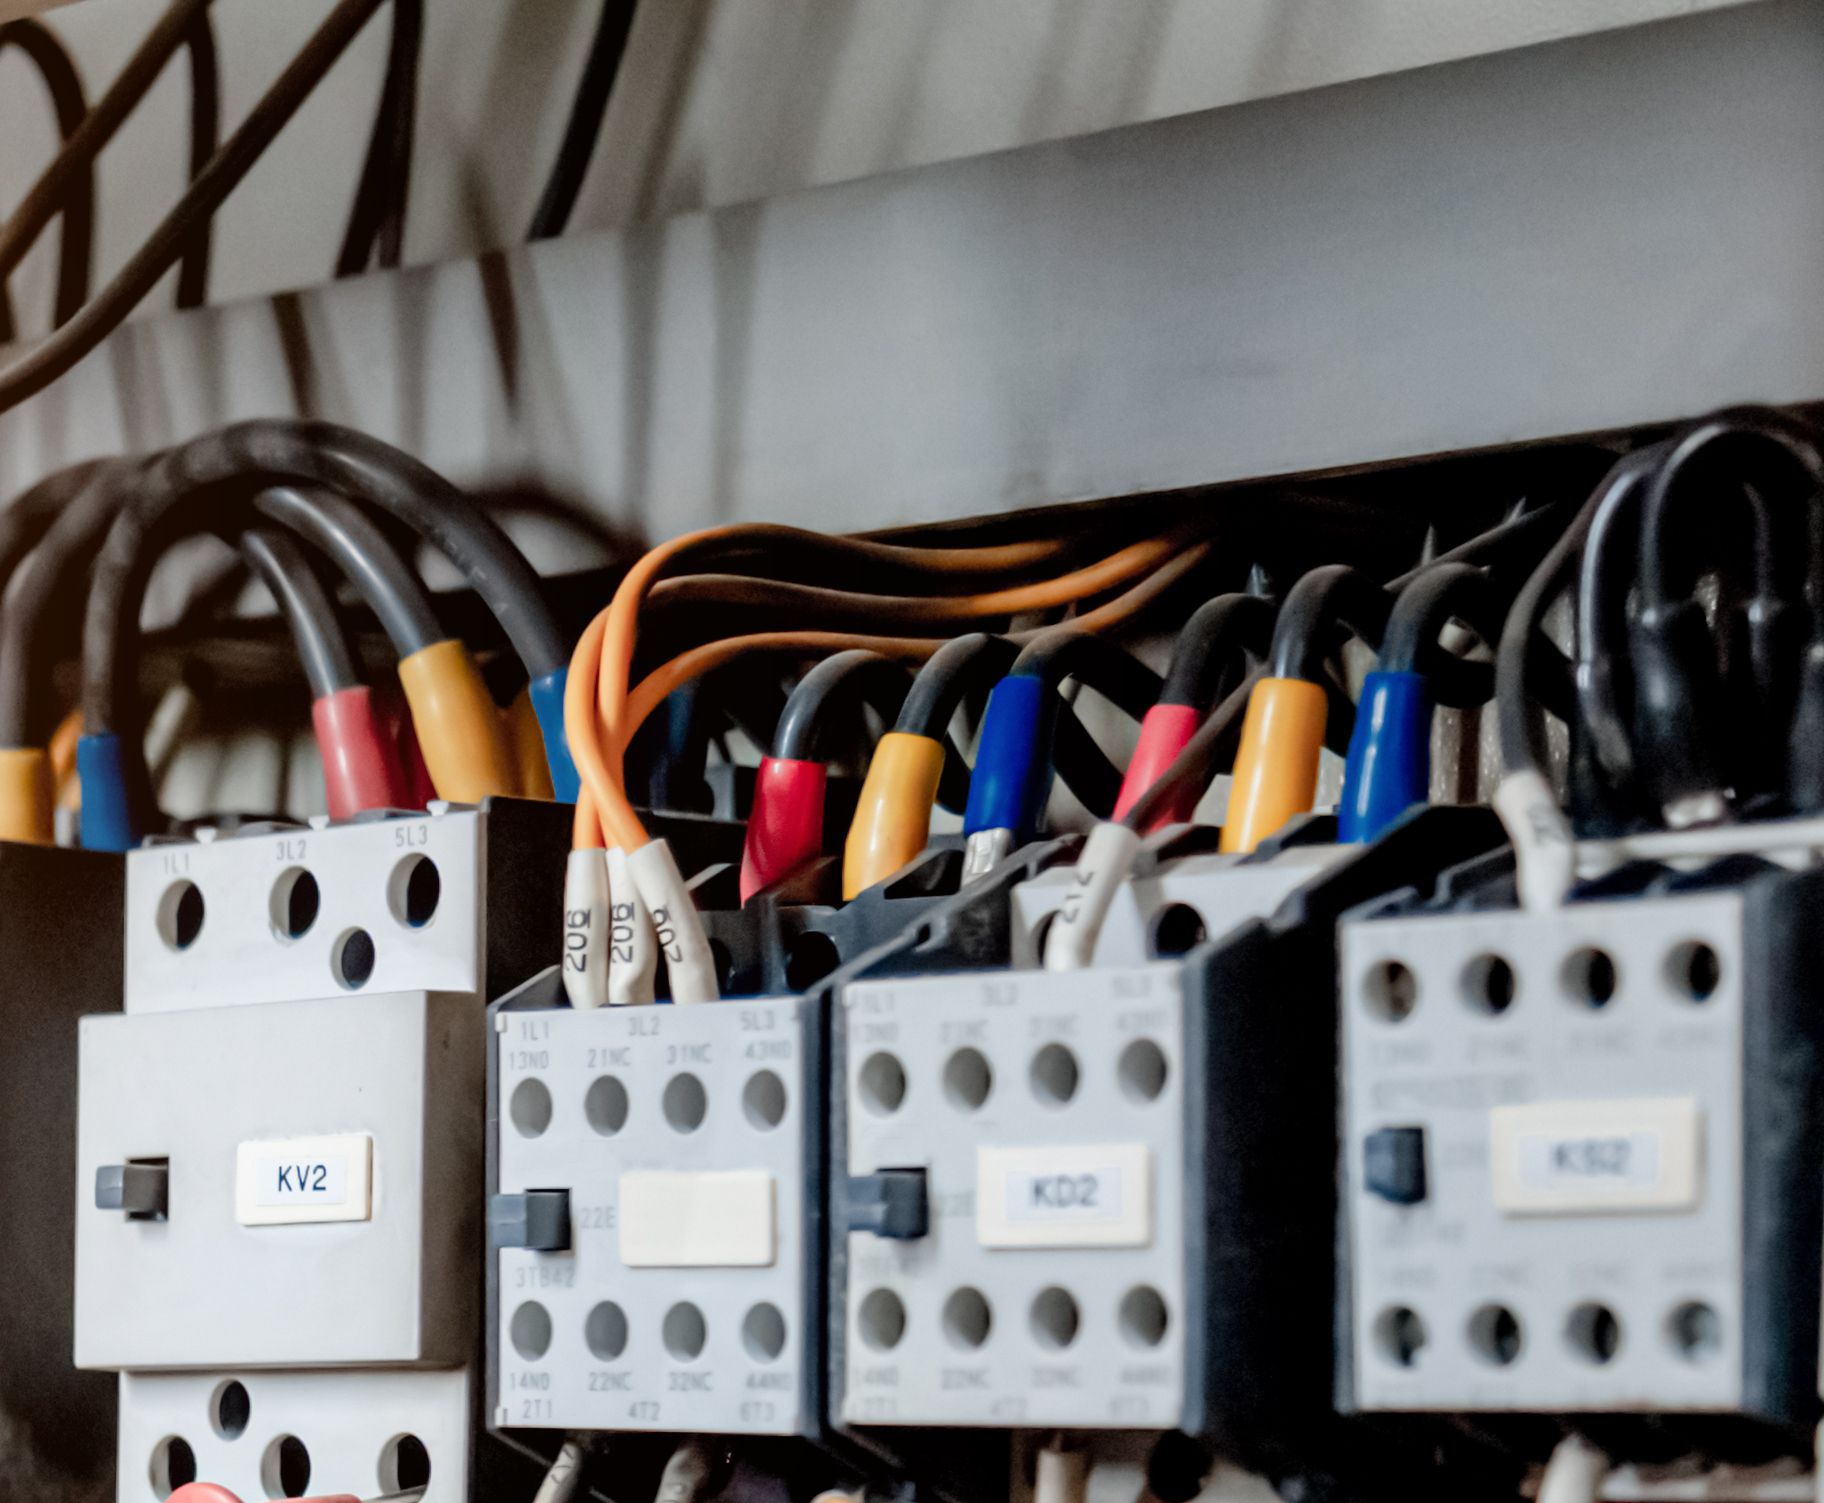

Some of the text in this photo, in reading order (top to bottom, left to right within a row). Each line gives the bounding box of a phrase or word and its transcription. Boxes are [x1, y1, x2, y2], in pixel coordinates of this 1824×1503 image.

[275, 839, 307, 862] 3L2
[394, 824, 429, 848] 5L3
[627, 1015, 661, 1037] 3L2
[738, 1010, 776, 1032] 5L3
[586, 1046, 632, 1069] 21NC
[665, 1043, 712, 1066] 31NC
[276, 1164, 328, 1193] KV2
[1031, 1172, 1099, 1209] KD2
[587, 1371, 633, 1393] 22NC
[667, 1370, 714, 1392] 32NC
[521, 1399, 552, 1420] 2T1
[627, 1402, 662, 1423] 4T2
